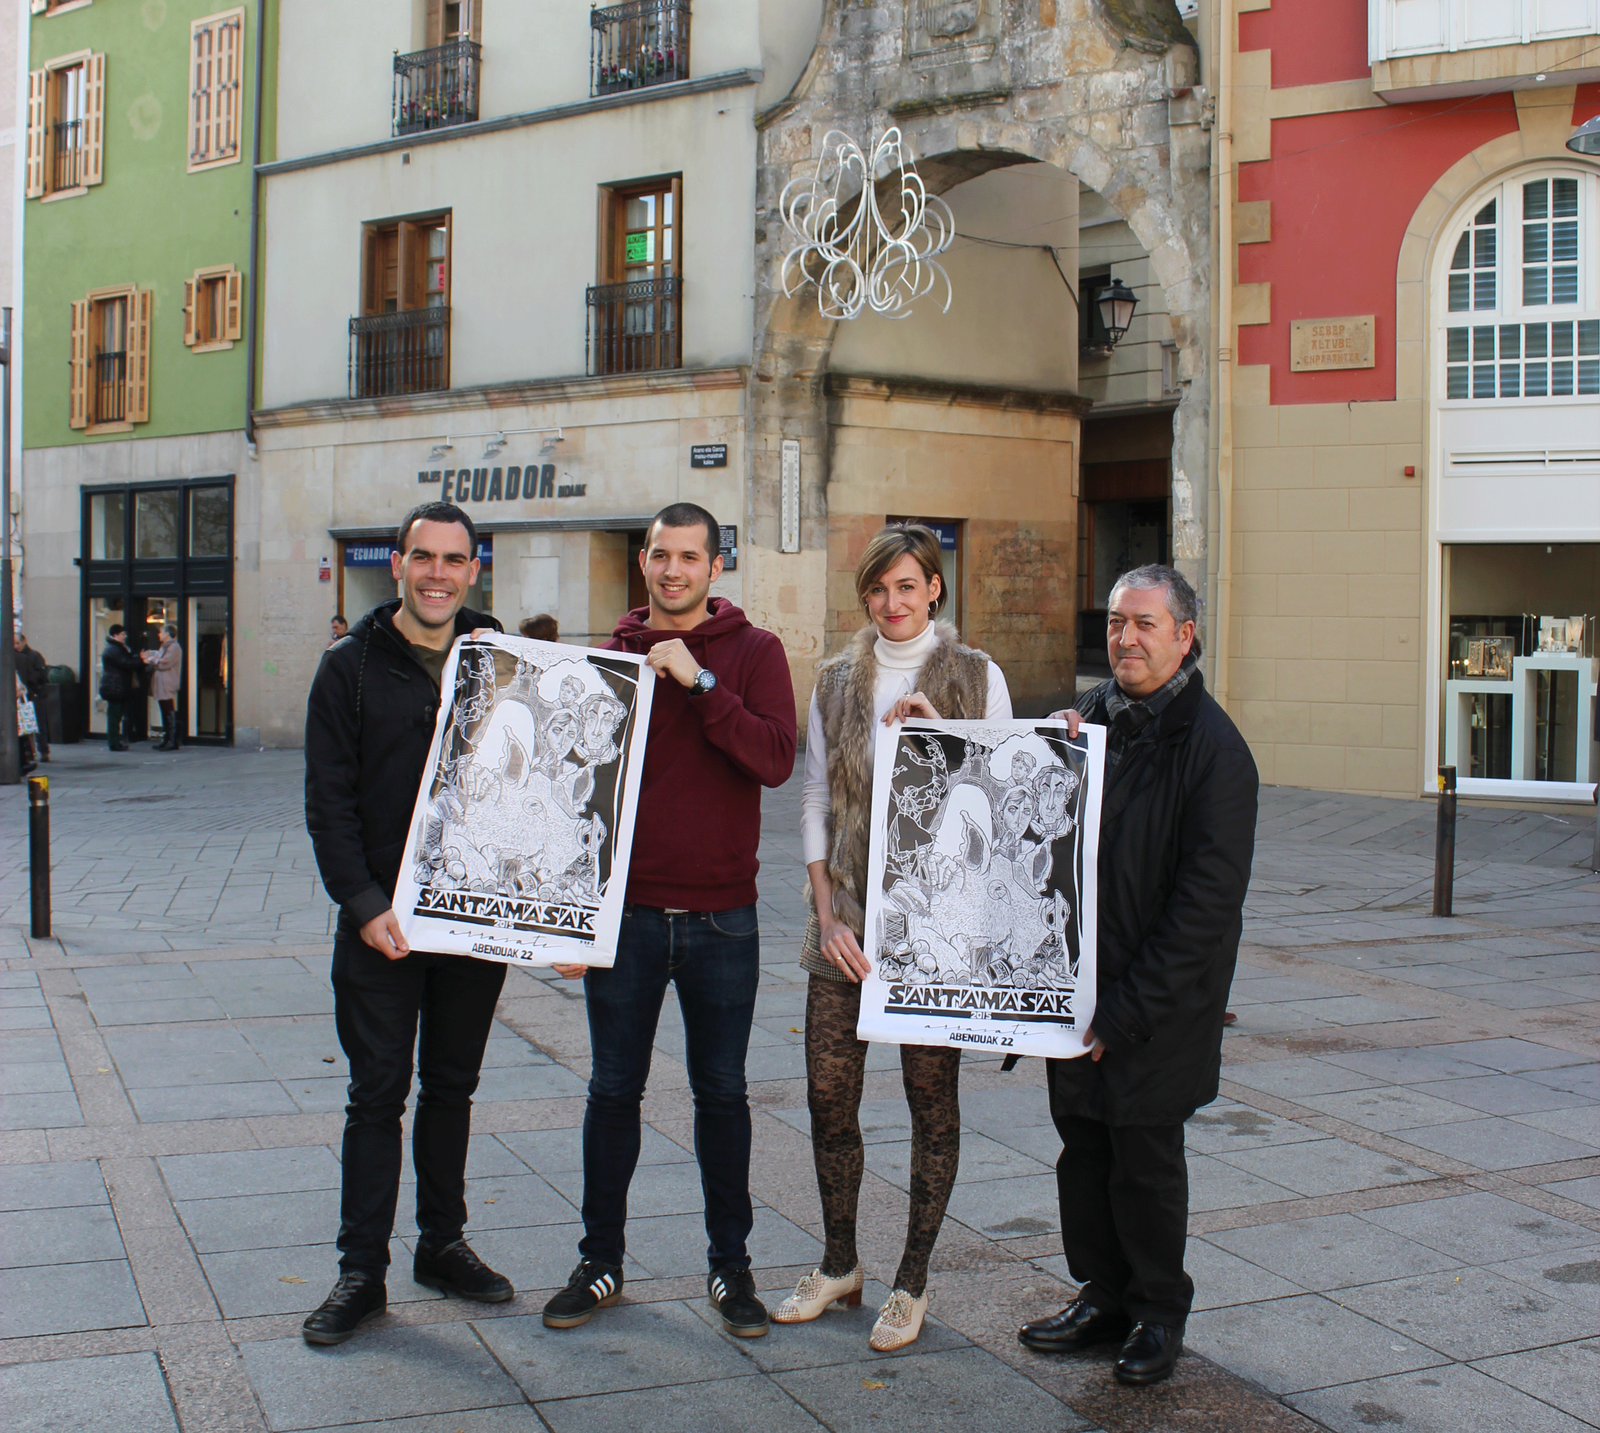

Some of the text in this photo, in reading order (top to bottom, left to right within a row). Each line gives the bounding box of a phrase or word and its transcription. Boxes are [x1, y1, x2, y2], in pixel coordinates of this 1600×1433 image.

[1312, 325, 1345, 337] SEBER
[441, 464, 555, 502] ECUADOR
[353, 547, 389, 561] ECUADOR
[417, 888, 596, 931] SANTAMASAK
[493, 919, 515, 929] 2015
[471, 943, 534, 960] ABENDUAK 22
[888, 985, 1073, 1014] SANTAMASAK
[970, 1011, 992, 1020] 2015
[949, 1032, 1014, 1047] ABENDUAK 22
